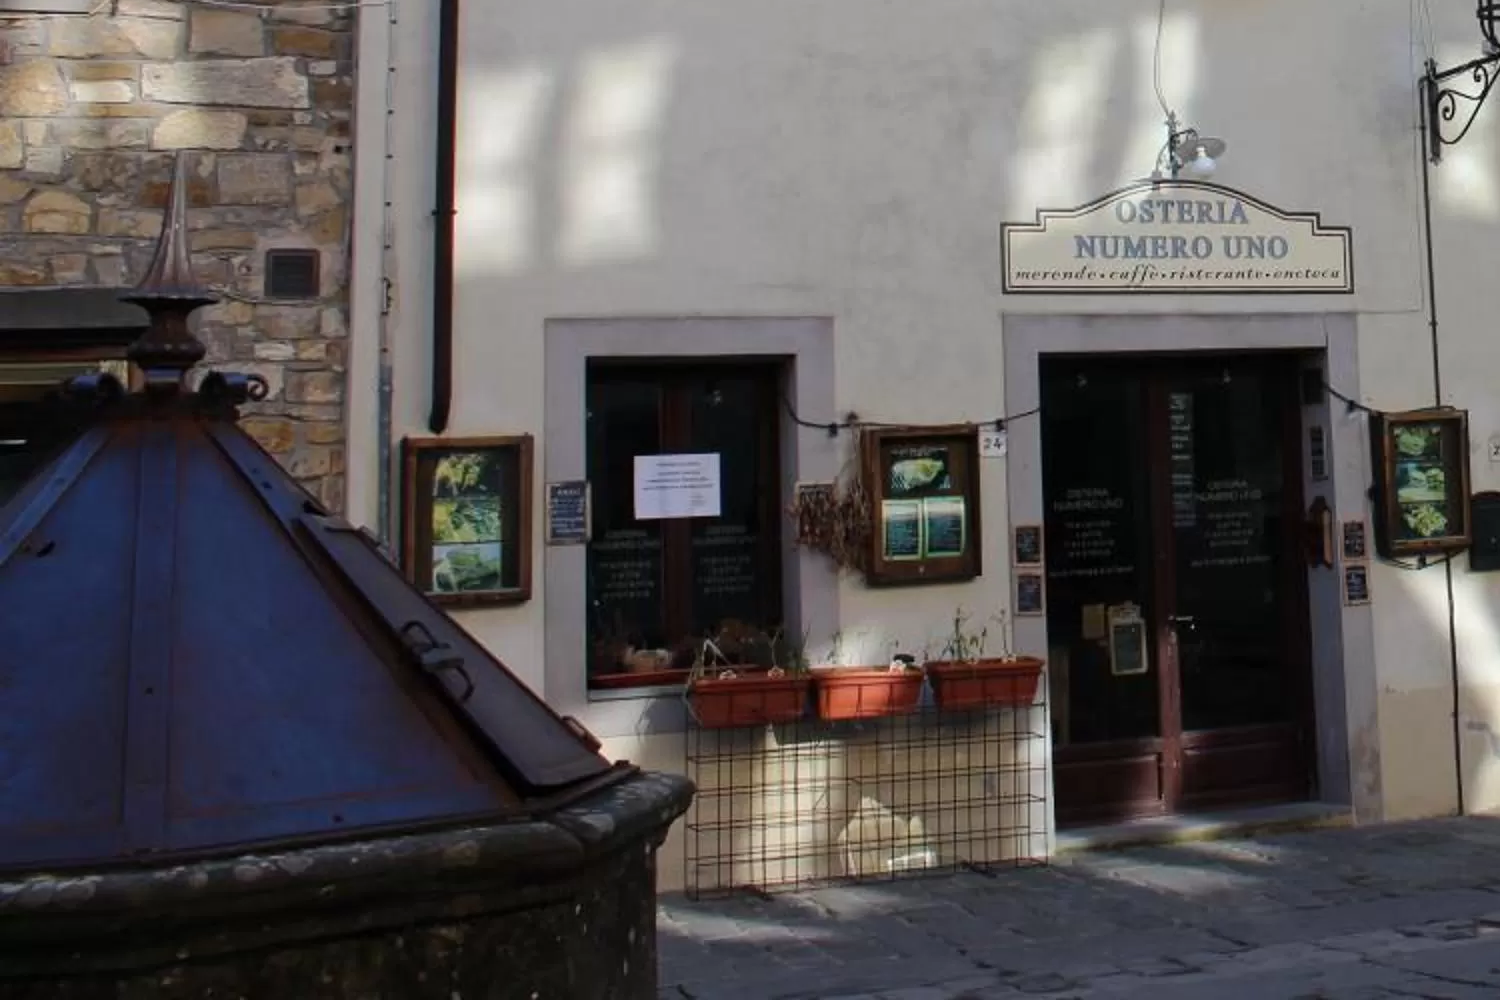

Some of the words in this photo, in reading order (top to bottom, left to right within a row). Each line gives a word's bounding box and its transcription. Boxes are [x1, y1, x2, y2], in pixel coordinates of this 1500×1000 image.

[1115, 199, 1249, 225] OSTERIA
[1073, 235, 1213, 260] NUMERO
[1222, 235, 1290, 260] UNO
[1015, 264, 1097, 281] merende
[983, 437, 1002, 450] 24
